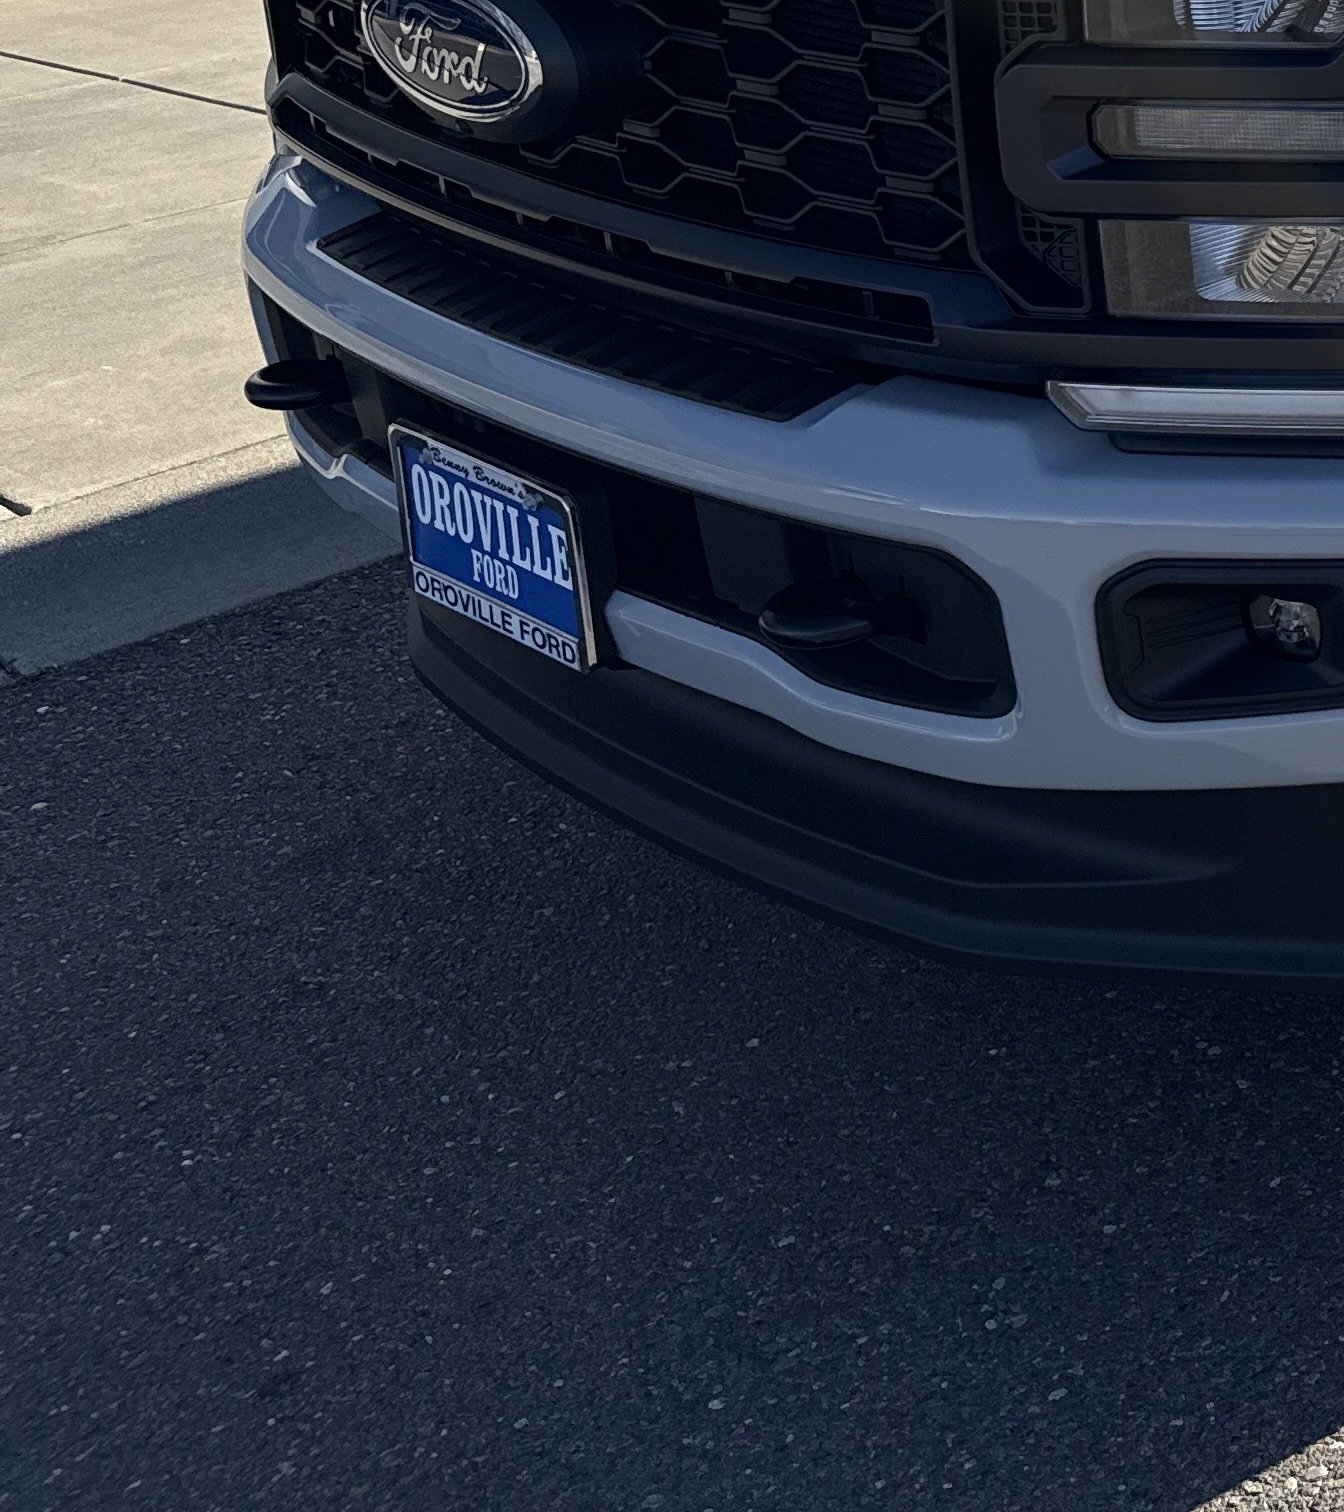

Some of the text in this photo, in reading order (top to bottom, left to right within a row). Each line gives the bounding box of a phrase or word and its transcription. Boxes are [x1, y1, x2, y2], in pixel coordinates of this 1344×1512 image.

[394, 2, 489, 94] Ford
[411, 463, 573, 591] OROVILLE
[415, 571, 576, 664] OROVILLE FORD
[471, 548, 519, 600] FORD
